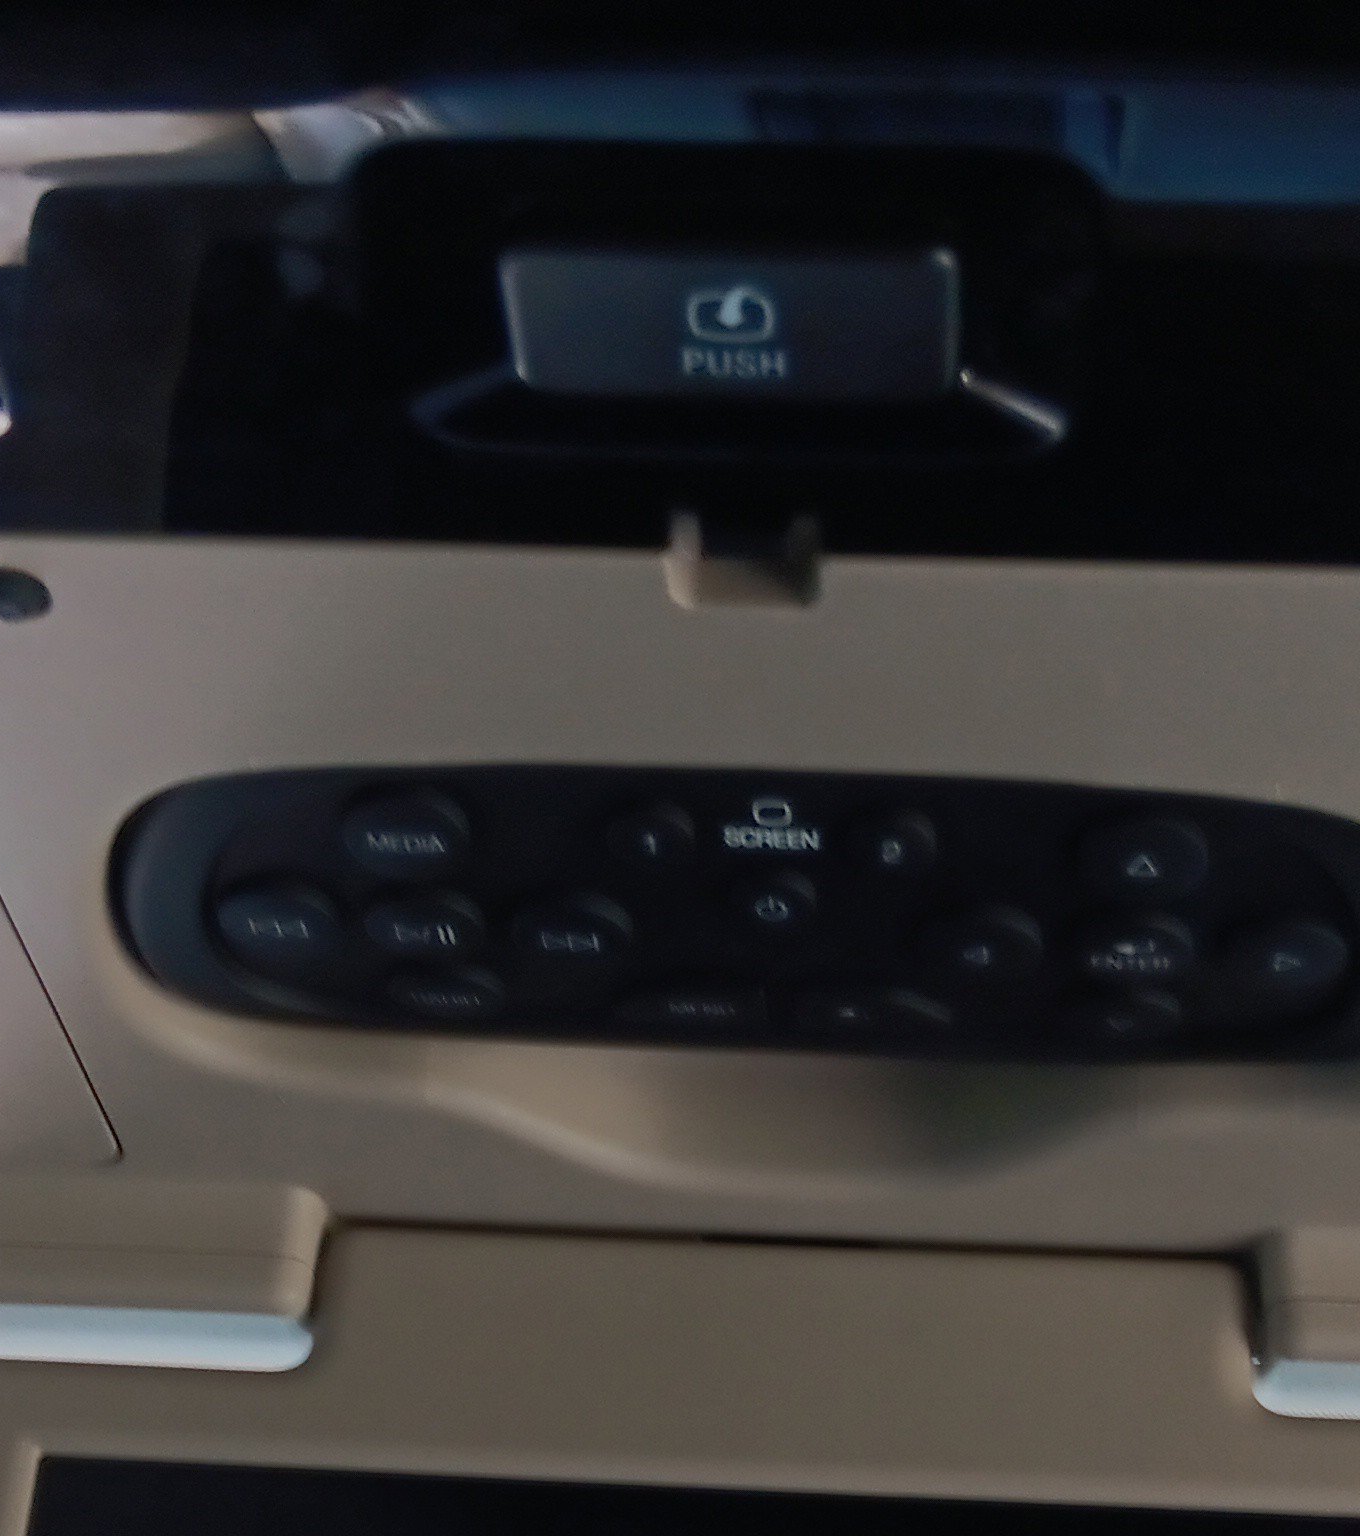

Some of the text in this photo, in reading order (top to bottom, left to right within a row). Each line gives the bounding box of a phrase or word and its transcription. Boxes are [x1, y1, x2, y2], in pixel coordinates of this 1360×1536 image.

[681, 346, 787, 378] PUSH
[365, 831, 446, 854] MEDIA
[723, 825, 820, 851] SCREEN
